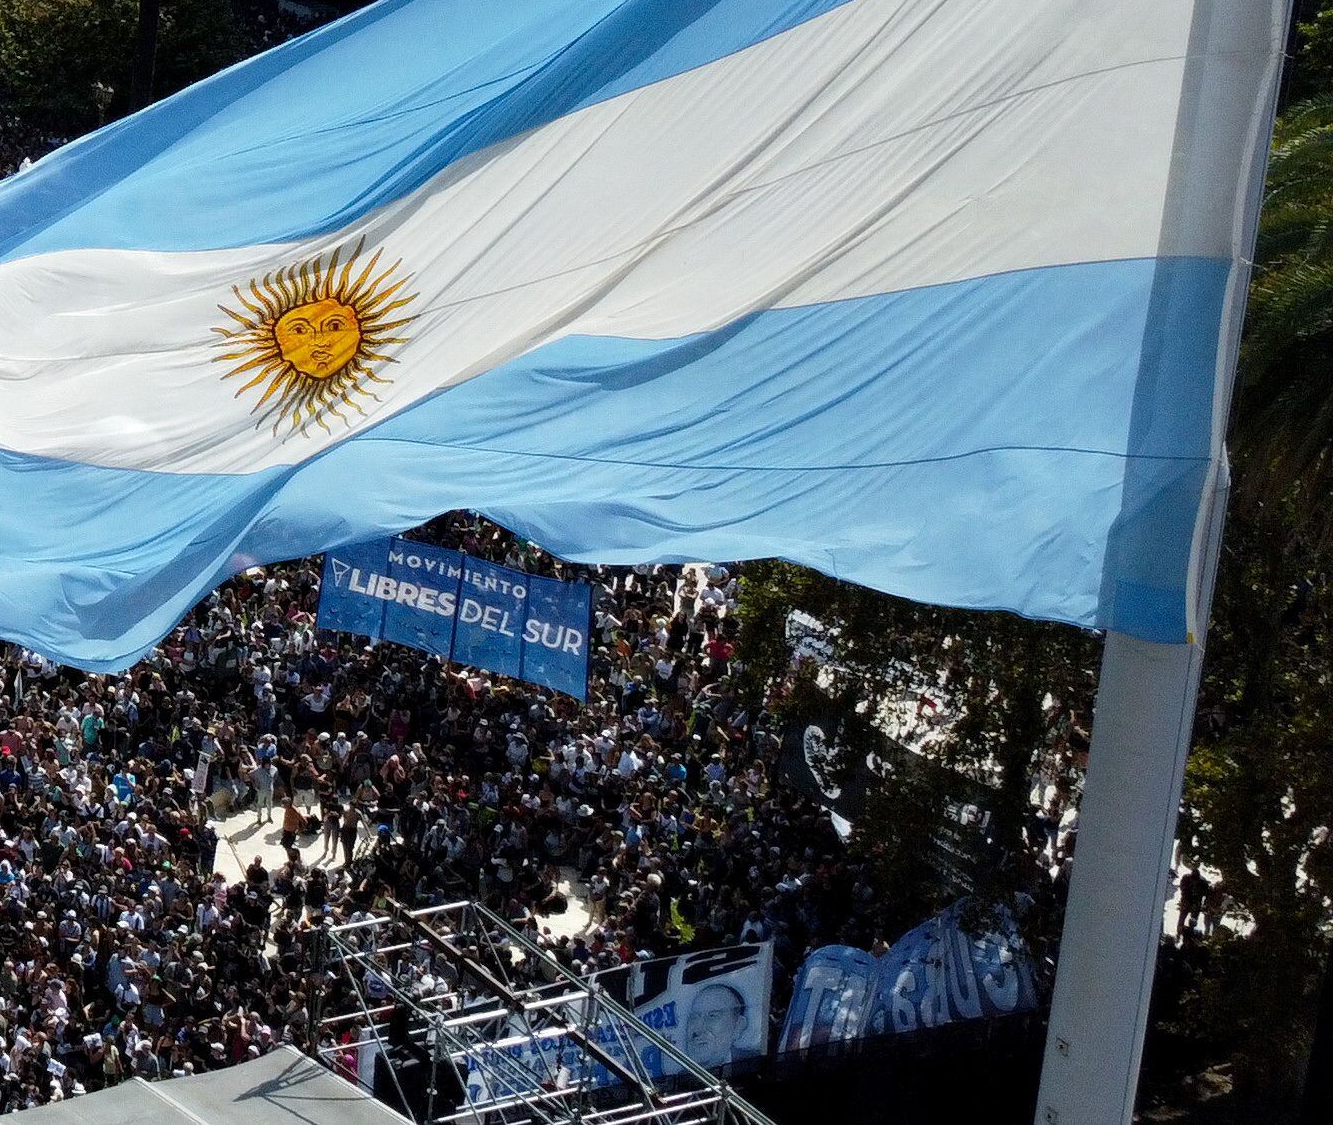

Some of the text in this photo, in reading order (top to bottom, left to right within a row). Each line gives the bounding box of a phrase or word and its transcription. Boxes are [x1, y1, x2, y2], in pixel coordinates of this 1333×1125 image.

[388, 550, 527, 600] MOVIMIENTO
[347, 568, 582, 656] LIBRES DEL SUR
